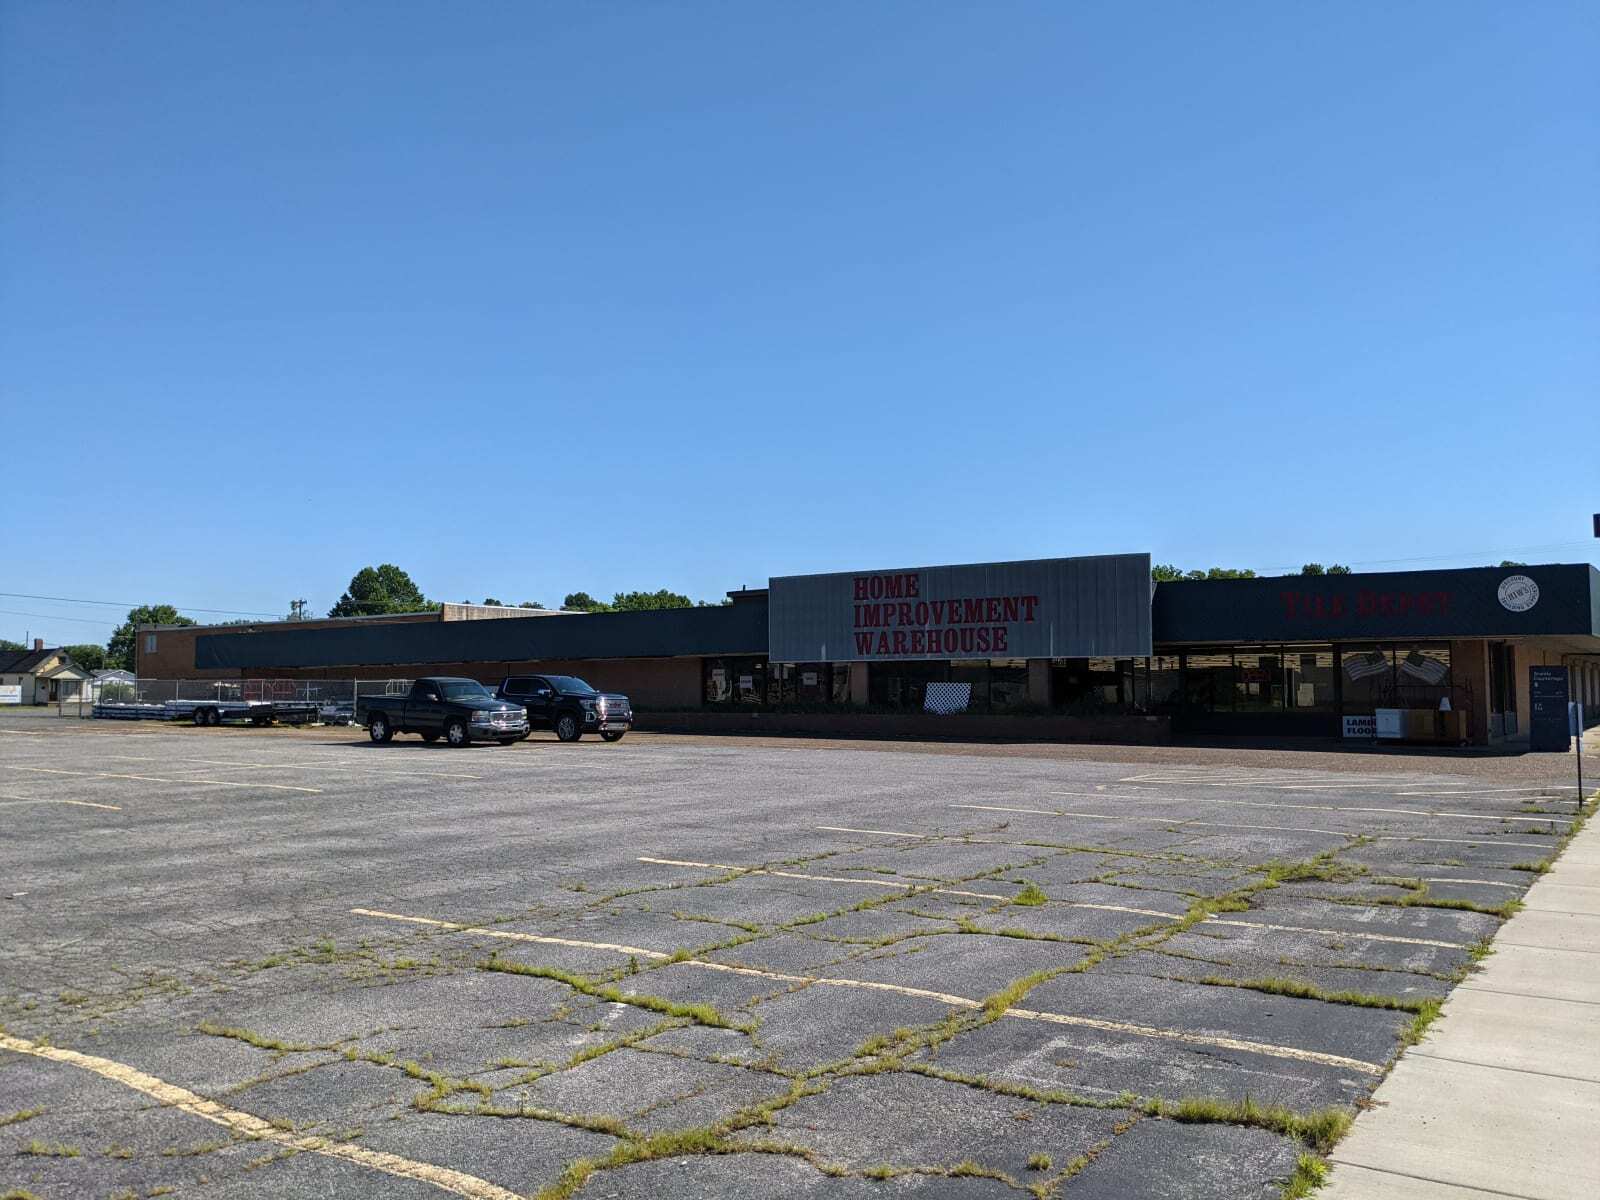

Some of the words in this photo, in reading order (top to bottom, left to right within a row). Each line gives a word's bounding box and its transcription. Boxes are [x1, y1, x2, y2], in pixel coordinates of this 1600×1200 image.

[853, 574, 919, 600] HOME
[853, 596, 1039, 628] IMPROVEMENT
[854, 627, 1008, 656] WAREHOUSE
